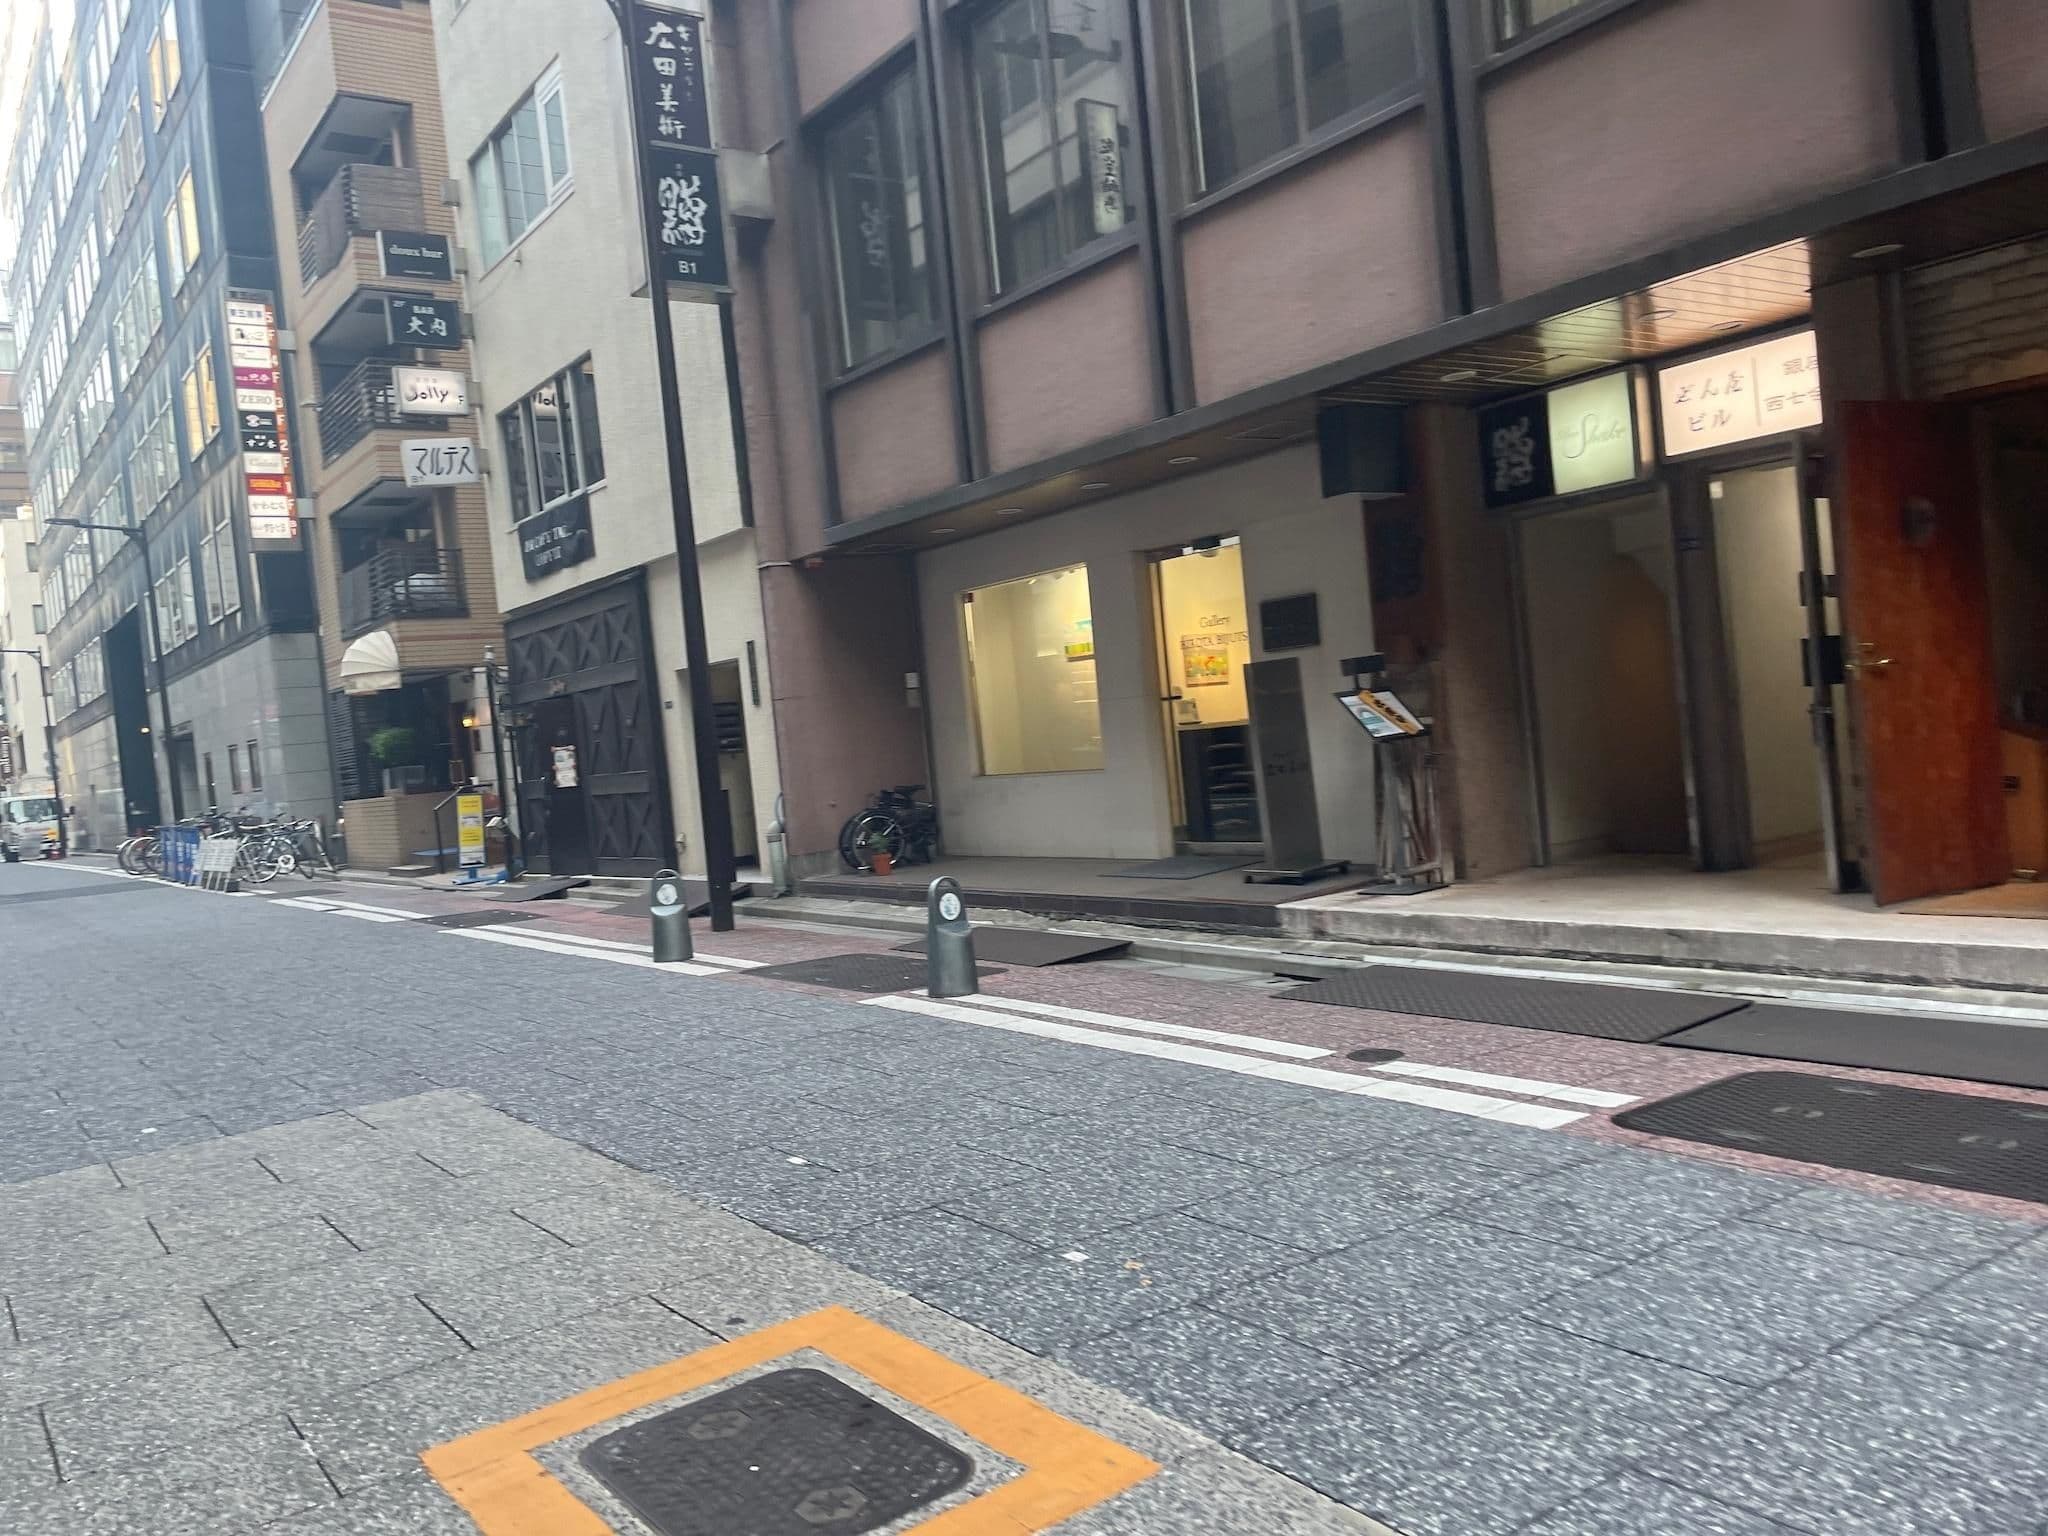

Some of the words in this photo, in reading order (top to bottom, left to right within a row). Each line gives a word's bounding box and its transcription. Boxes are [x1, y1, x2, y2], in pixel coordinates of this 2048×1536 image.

[678, 260, 697, 274] B1
[406, 316, 448, 336] 大内
[240, 394, 272, 405] ZERO
[404, 384, 449, 403] Jolly
[1688, 408, 1733, 433] ビル
[410, 446, 474, 476] マルテス
[1199, 614, 1231, 629] Gallery
